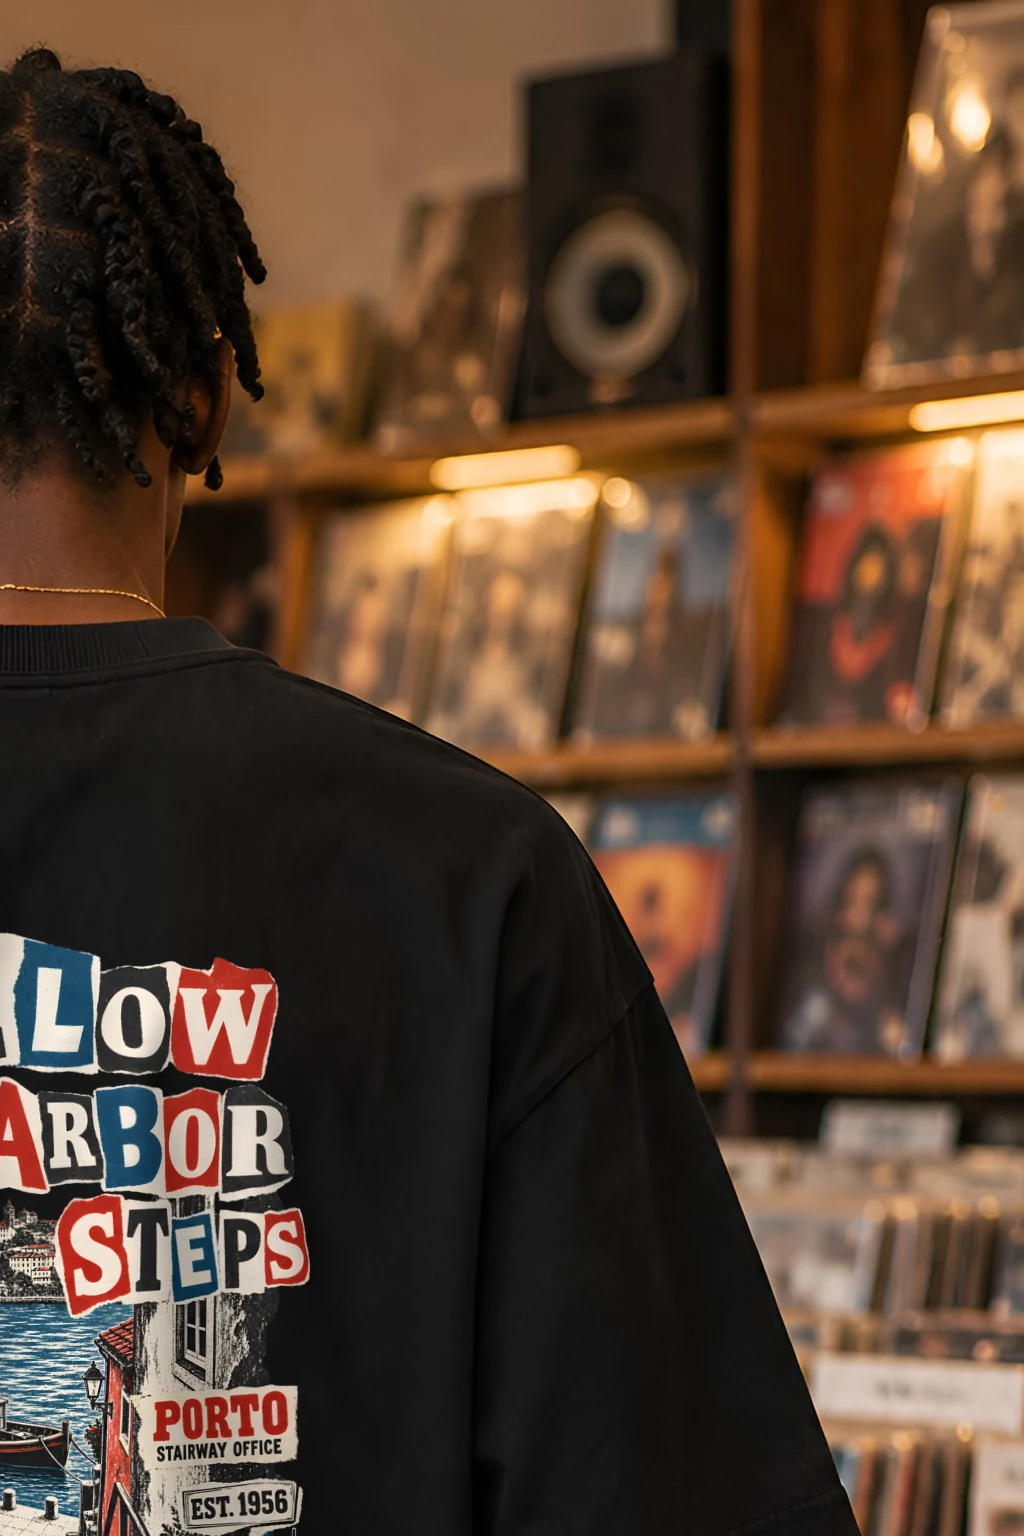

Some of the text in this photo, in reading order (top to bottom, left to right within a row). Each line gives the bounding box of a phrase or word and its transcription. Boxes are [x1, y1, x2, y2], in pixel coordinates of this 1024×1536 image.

[72, 1209, 305, 1298] STEPS
[152, 1390, 289, 1442] PORTO
[156, 1438, 283, 1462] STAIRWAY OFFICE
[190, 1489, 288, 1520] EST. 1956
